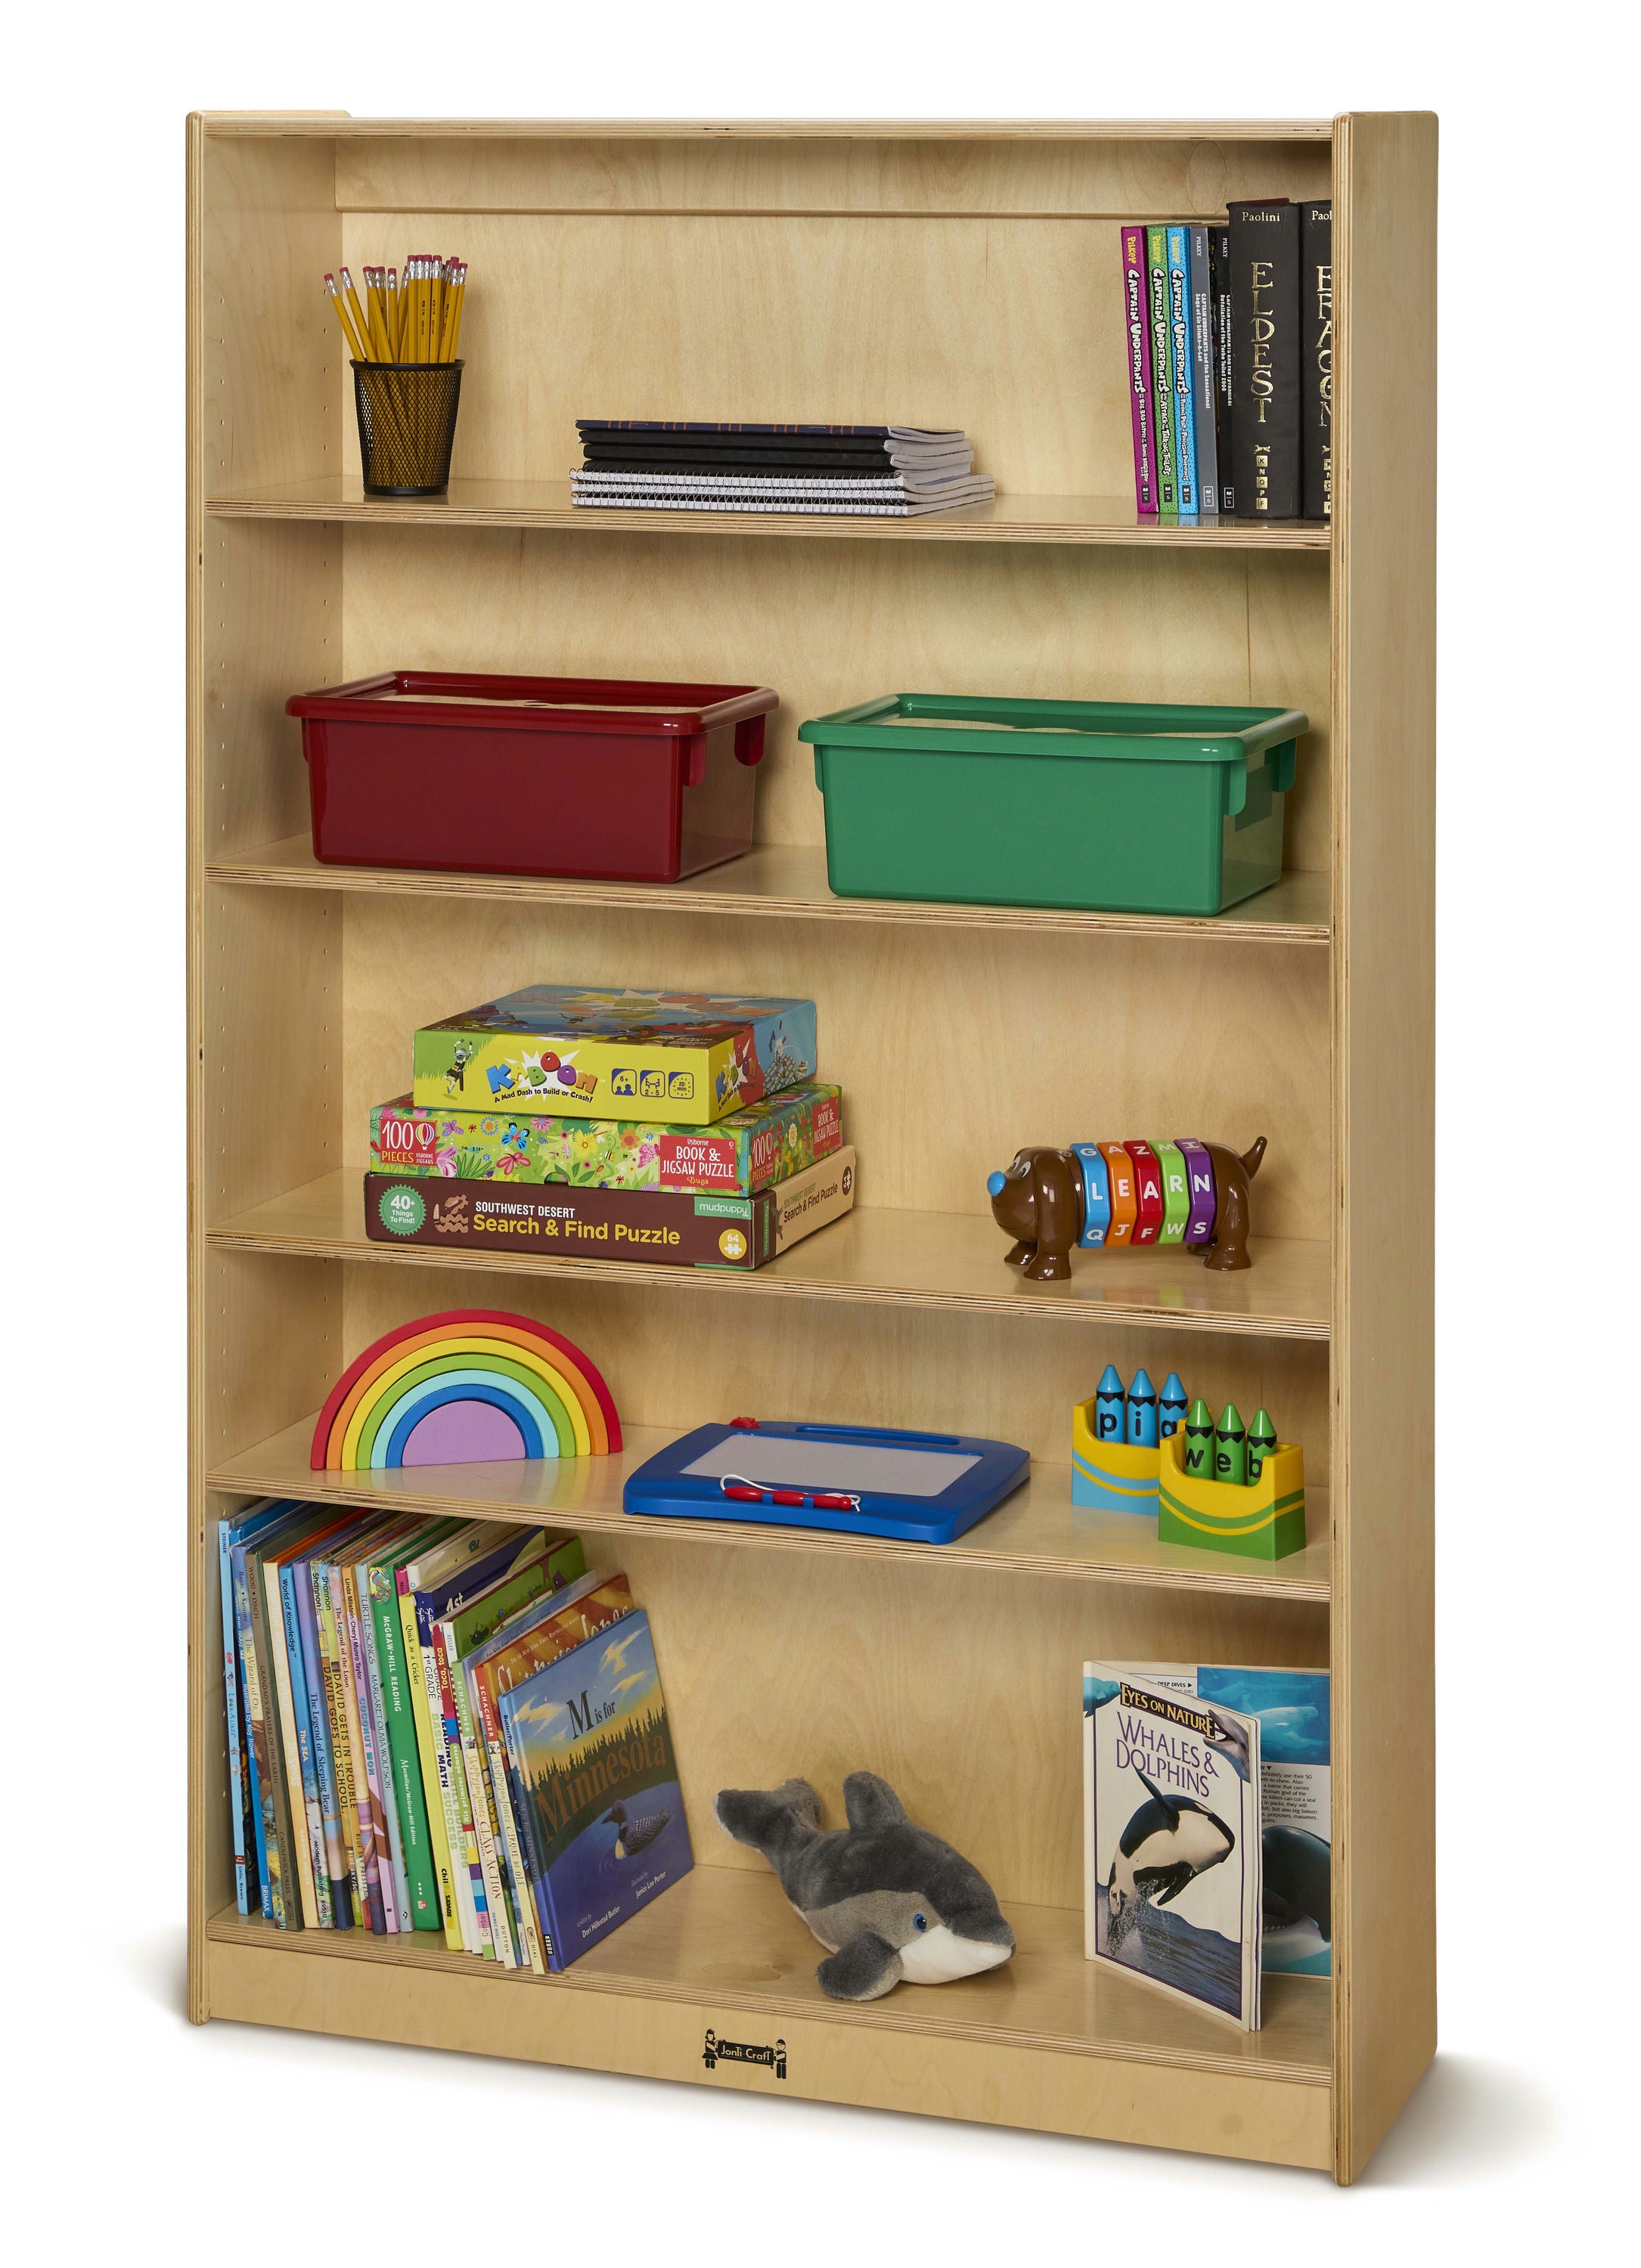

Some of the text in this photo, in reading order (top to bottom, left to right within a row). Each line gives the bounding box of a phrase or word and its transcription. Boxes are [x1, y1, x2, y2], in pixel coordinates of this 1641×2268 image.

[1241, 211, 1281, 222] Paolini
[1311, 210, 1332, 220] Paol
[1130, 321, 1147, 394] UNDERPANTS
[1153, 321, 1171, 393] UNDERPANTS
[1173, 321, 1191, 394] UNDERPANTS
[1250, 262, 1275, 423] ELDEST
[1256, 455, 1268, 510] KNOPF
[485, 1052, 597, 1095] KABOOM
[501, 1091, 516, 1101] Mad
[516, 1087, 533, 1096] Dash
[543, 1087, 560, 1095] Build
[570, 1090, 594, 1104] Crash!
[817, 1111, 829, 1126] BOOK
[382, 1120, 414, 1151] 100
[687, 1138, 709, 1147] Usborne
[752, 1136, 765, 1167] 100
[381, 1151, 414, 1164] PIECES
[661, 1159, 735, 1178] JIGSAW PUZZLE
[675, 1146, 721, 1162] BOOK &
[687, 1176, 709, 1185] Bugs
[1092, 1174, 1210, 1201] LEARN
[390, 1194, 416, 1210] 40+
[391, 1210, 414, 1218] Things
[475, 1201, 575, 1218] SOUTHWEST DESERT
[700, 1202, 749, 1217] mudpuppy
[783, 1183, 838, 1222] Search Find Puzzle
[473, 1213, 681, 1245] Search & Find Puzzle
[727, 1233, 740, 1242] 64
[1186, 1448, 1263, 1479] web
[284, 1601, 291, 1610] of
[312, 1572, 321, 1607] Shannon
[321, 1576, 331, 1611] Shannon
[287, 1611, 295, 1653] Knowledge
[337, 1622, 346, 1646] Legend
[361, 1594, 376, 1665] TURTLE SONGS
[405, 1625, 414, 1643] Quick
[247, 1656, 257, 1685] Wizard
[425, 1666, 436, 1699] GRADE
[440, 1668, 448, 1690] Toca,
[310, 1692, 318, 1709] The
[390, 1676, 402, 1712] READING
[456, 1681, 470, 1732] SCHACHNER
[311, 1710, 322, 1741] Legend
[371, 1675, 386, 1747] MARGARET OLIVIA
[479, 1685, 494, 1737] SCHACHNER
[566, 1690, 616, 1740] M is for
[1121, 1684, 1215, 1739] EYES ON NATURE
[315, 1742, 324, 1752] of
[324, 1666, 348, 1814] DAVID GOES TO SCHOOL.
[333, 1674, 357, 1808] DAVID GETS IN TROUBLE
[358, 1696, 375, 1775] COCONUT MON
[432, 1713, 443, 1750] BASIC
[504, 1715, 514, 1755] Butler/Porter
[1116, 1711, 1220, 1778] WHALES &
[318, 1755, 327, 1792] Sleeping
[437, 1755, 449, 1788] MATH
[1116, 1739, 1210, 1798] DOLPHINS
[400, 1759, 415, 1825] Macmillan/McGraw-Hill
[458, 1777, 468, 1808] primeros
[533, 1734, 668, 1845] Minnesota
[443, 1791, 458, 1850] SUCCESS
[479, 1821, 495, 1854] CLASS
[506, 1826, 519, 1861] CIRQUE
[486, 1859, 502, 1899] ACTION
[636, 1885, 647, 1899] Janice
[654, 1871, 666, 1884] Porter
[261, 1885, 270, 1912] BRIMAX
[479, 1913, 489, 1937] Combel
[582, 1926, 592, 1938] Dori
[591, 1914, 609, 1932] Hillestad
[608, 1905, 621, 1919] Butler
[501, 1926, 510, 1954] DUTTON
